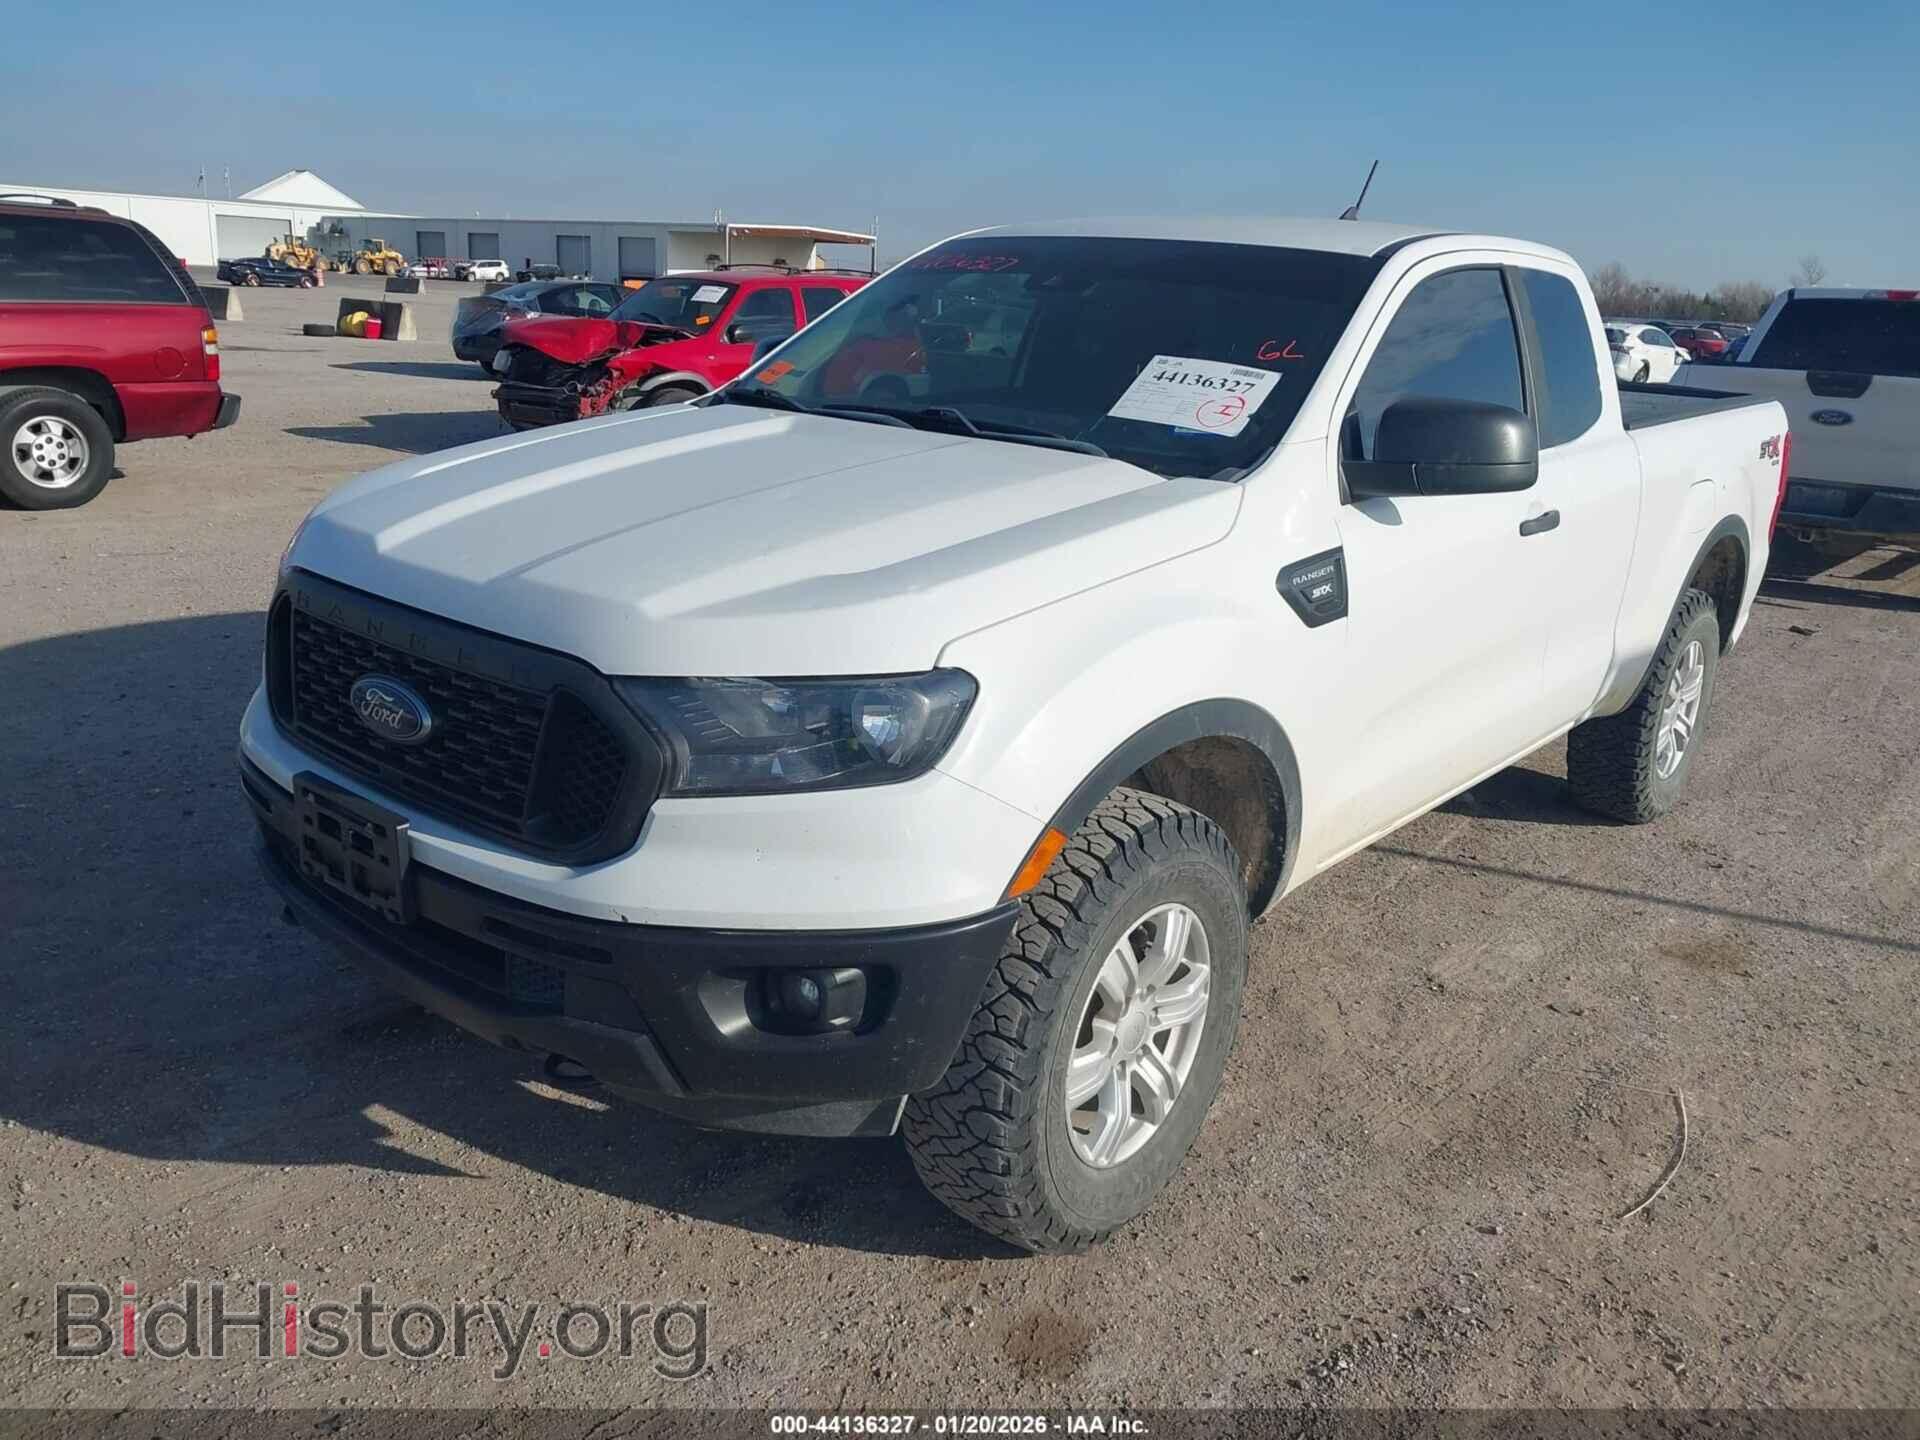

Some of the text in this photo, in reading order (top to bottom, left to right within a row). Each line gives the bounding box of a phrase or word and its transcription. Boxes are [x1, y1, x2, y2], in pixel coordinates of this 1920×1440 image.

[1152, 369, 1256, 395] 44136327
[1759, 434, 1781, 460] STX
[1292, 564, 1335, 586] RANGER
[1311, 583, 1333, 599] STX
[359, 687, 404, 730] Ford
